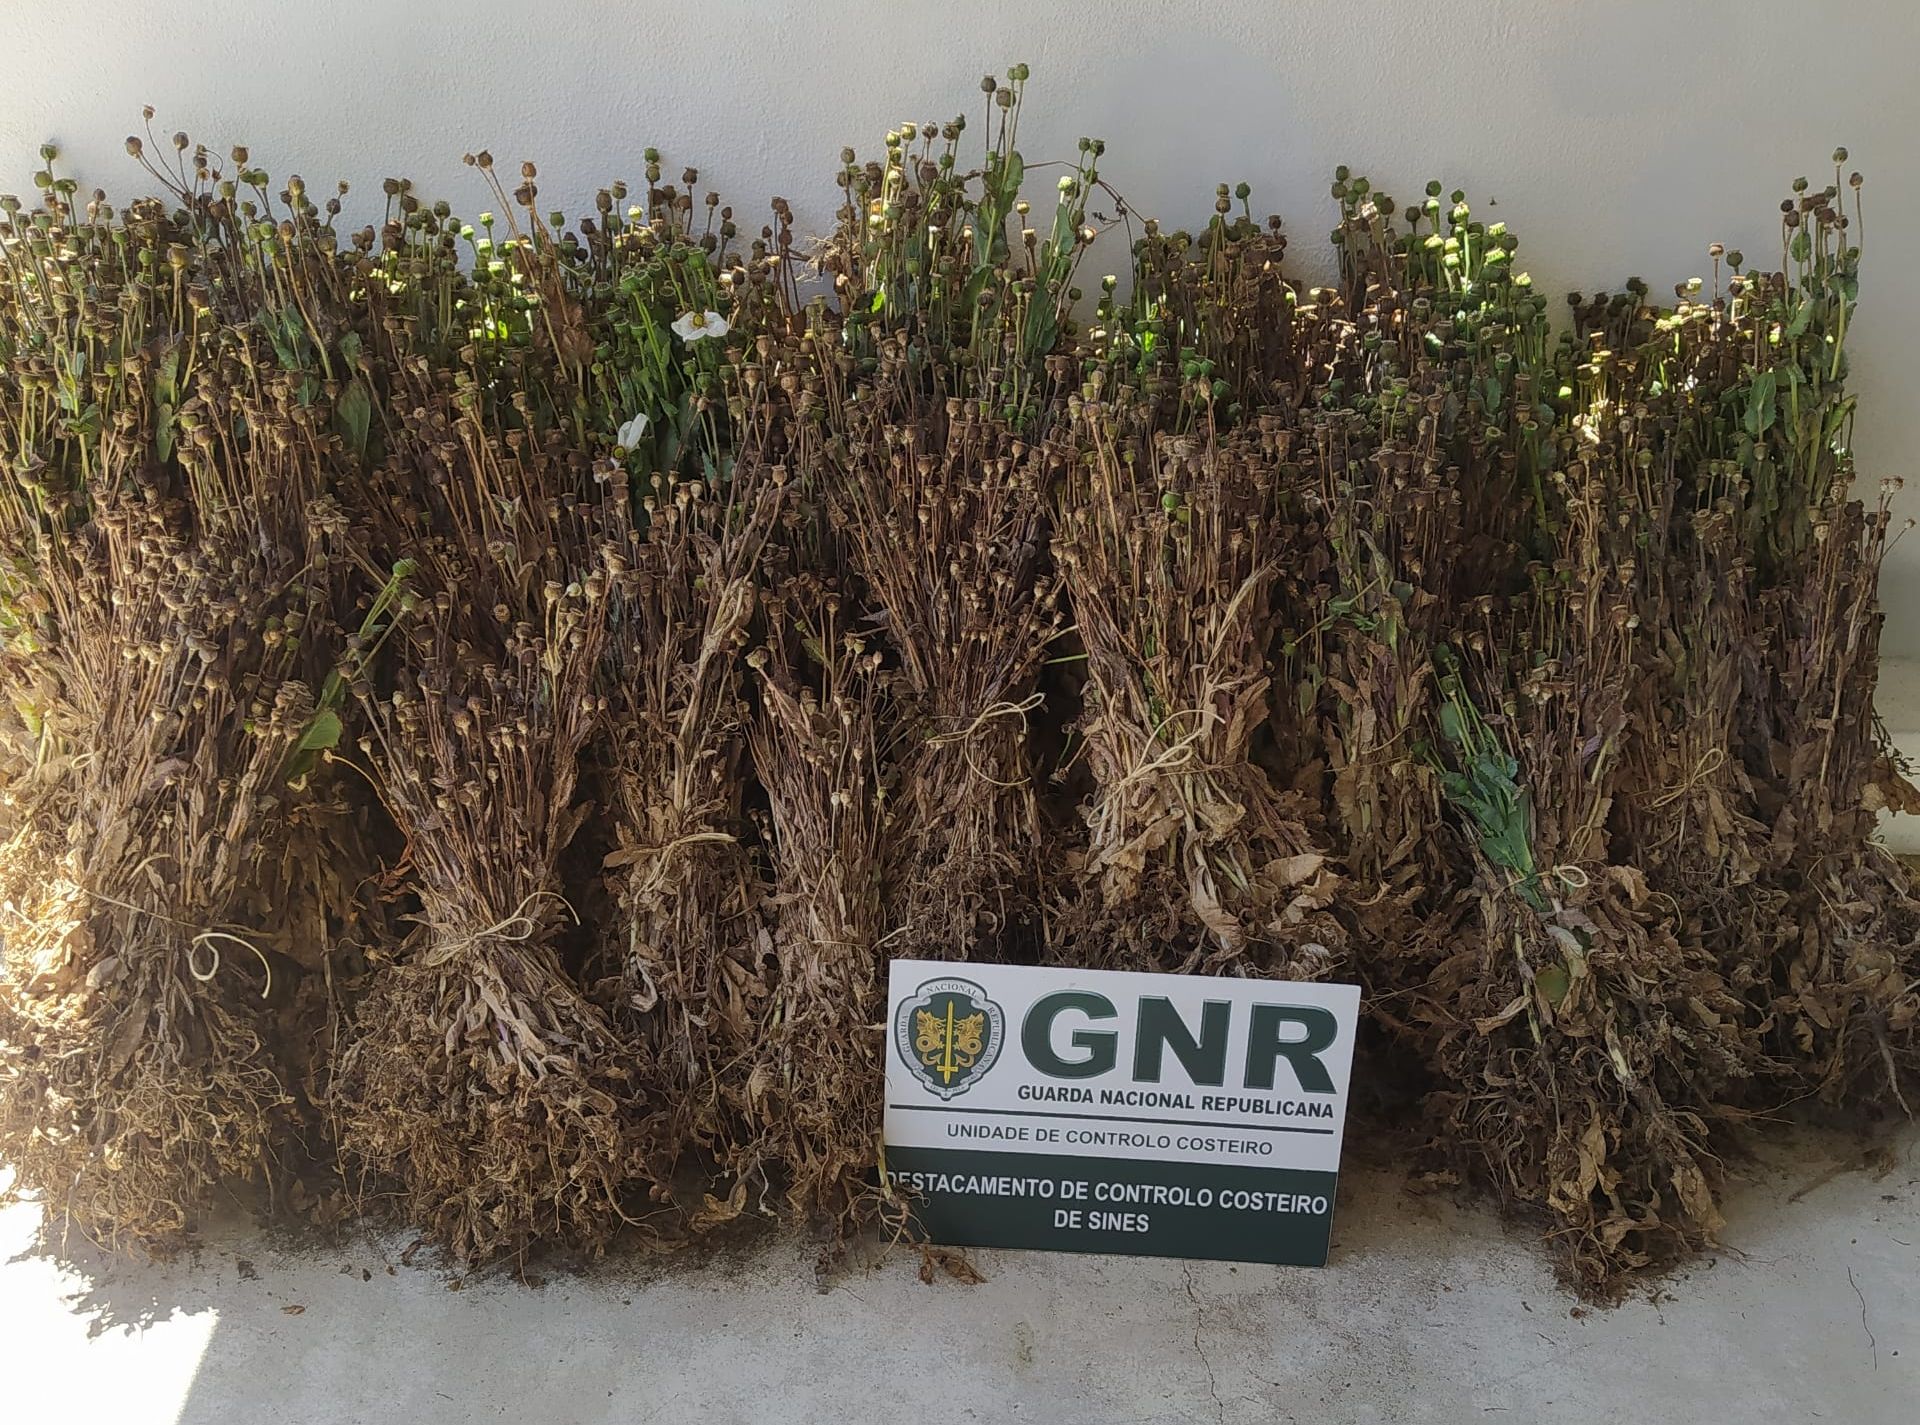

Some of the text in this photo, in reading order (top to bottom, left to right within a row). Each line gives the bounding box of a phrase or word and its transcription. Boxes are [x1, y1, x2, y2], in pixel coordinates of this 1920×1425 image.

[900, 1014, 909, 1053] GUARDA
[926, 982, 978, 998] NACIONAL
[1021, 989, 1338, 1094] GNR
[1018, 1084, 1334, 1118] GUARDA NACIONAL REPUBLICANA
[947, 1123, 1273, 1155] UNIDADE DE CONTROLO COSTEIRO
[1060, 1181, 1089, 1200] DE
[1094, 1182, 1213, 1208] CONTROLO
[1219, 1189, 1328, 1215] COSTEIRO
[1053, 1209, 1150, 1233] DE SINES
